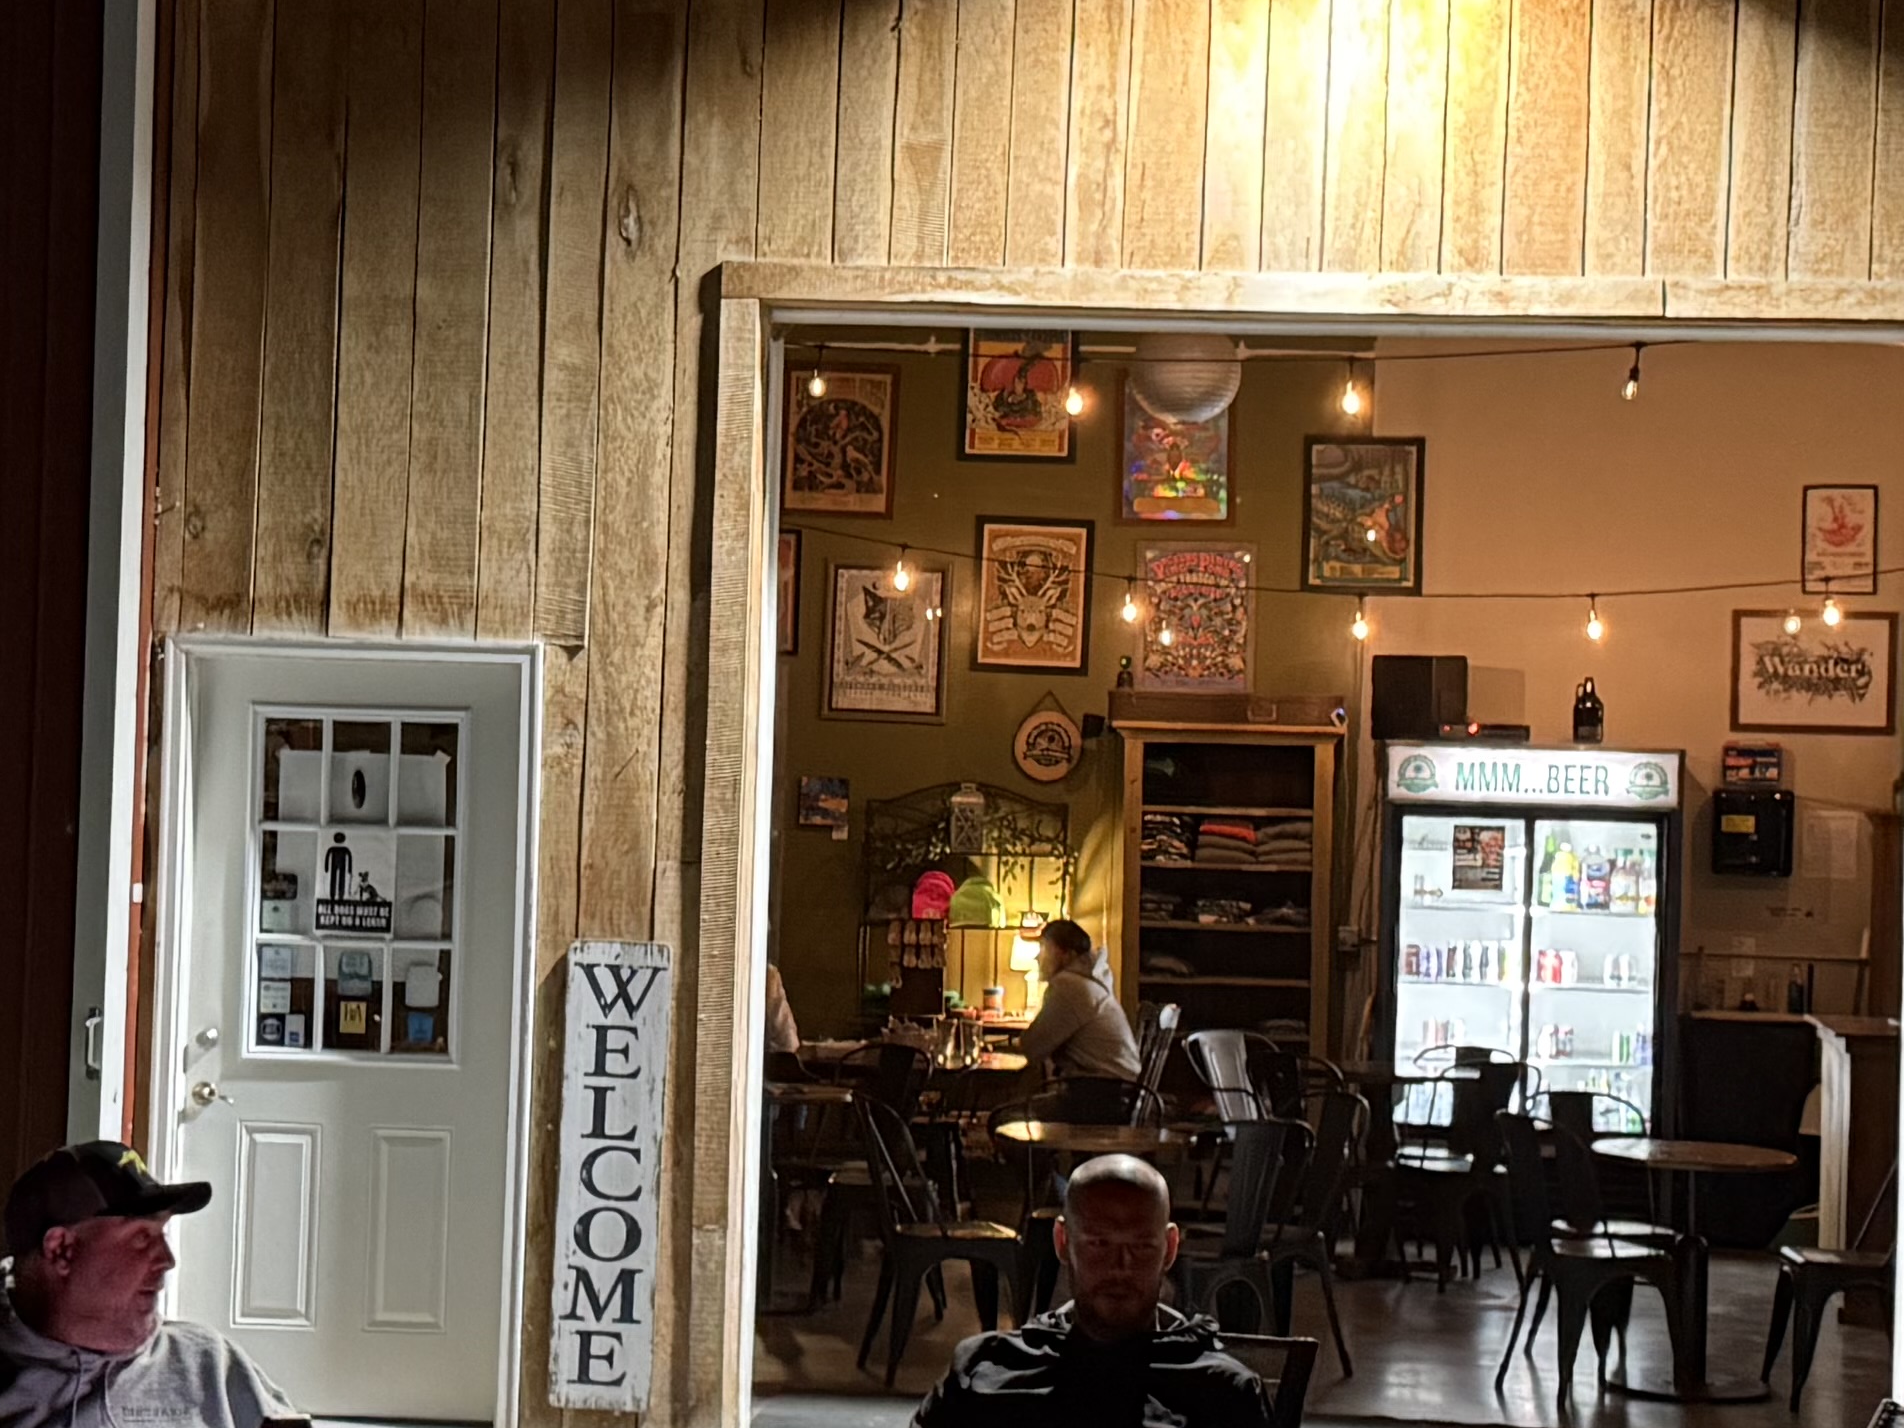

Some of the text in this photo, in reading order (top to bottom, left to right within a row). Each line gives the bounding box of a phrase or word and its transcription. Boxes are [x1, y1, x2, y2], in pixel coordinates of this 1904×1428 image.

[317, 903, 331, 915] ALL
[334, 904, 354, 915] DOGS
[356, 905, 377, 917] MUST
[559, 962, 669, 1387] WELCOME
